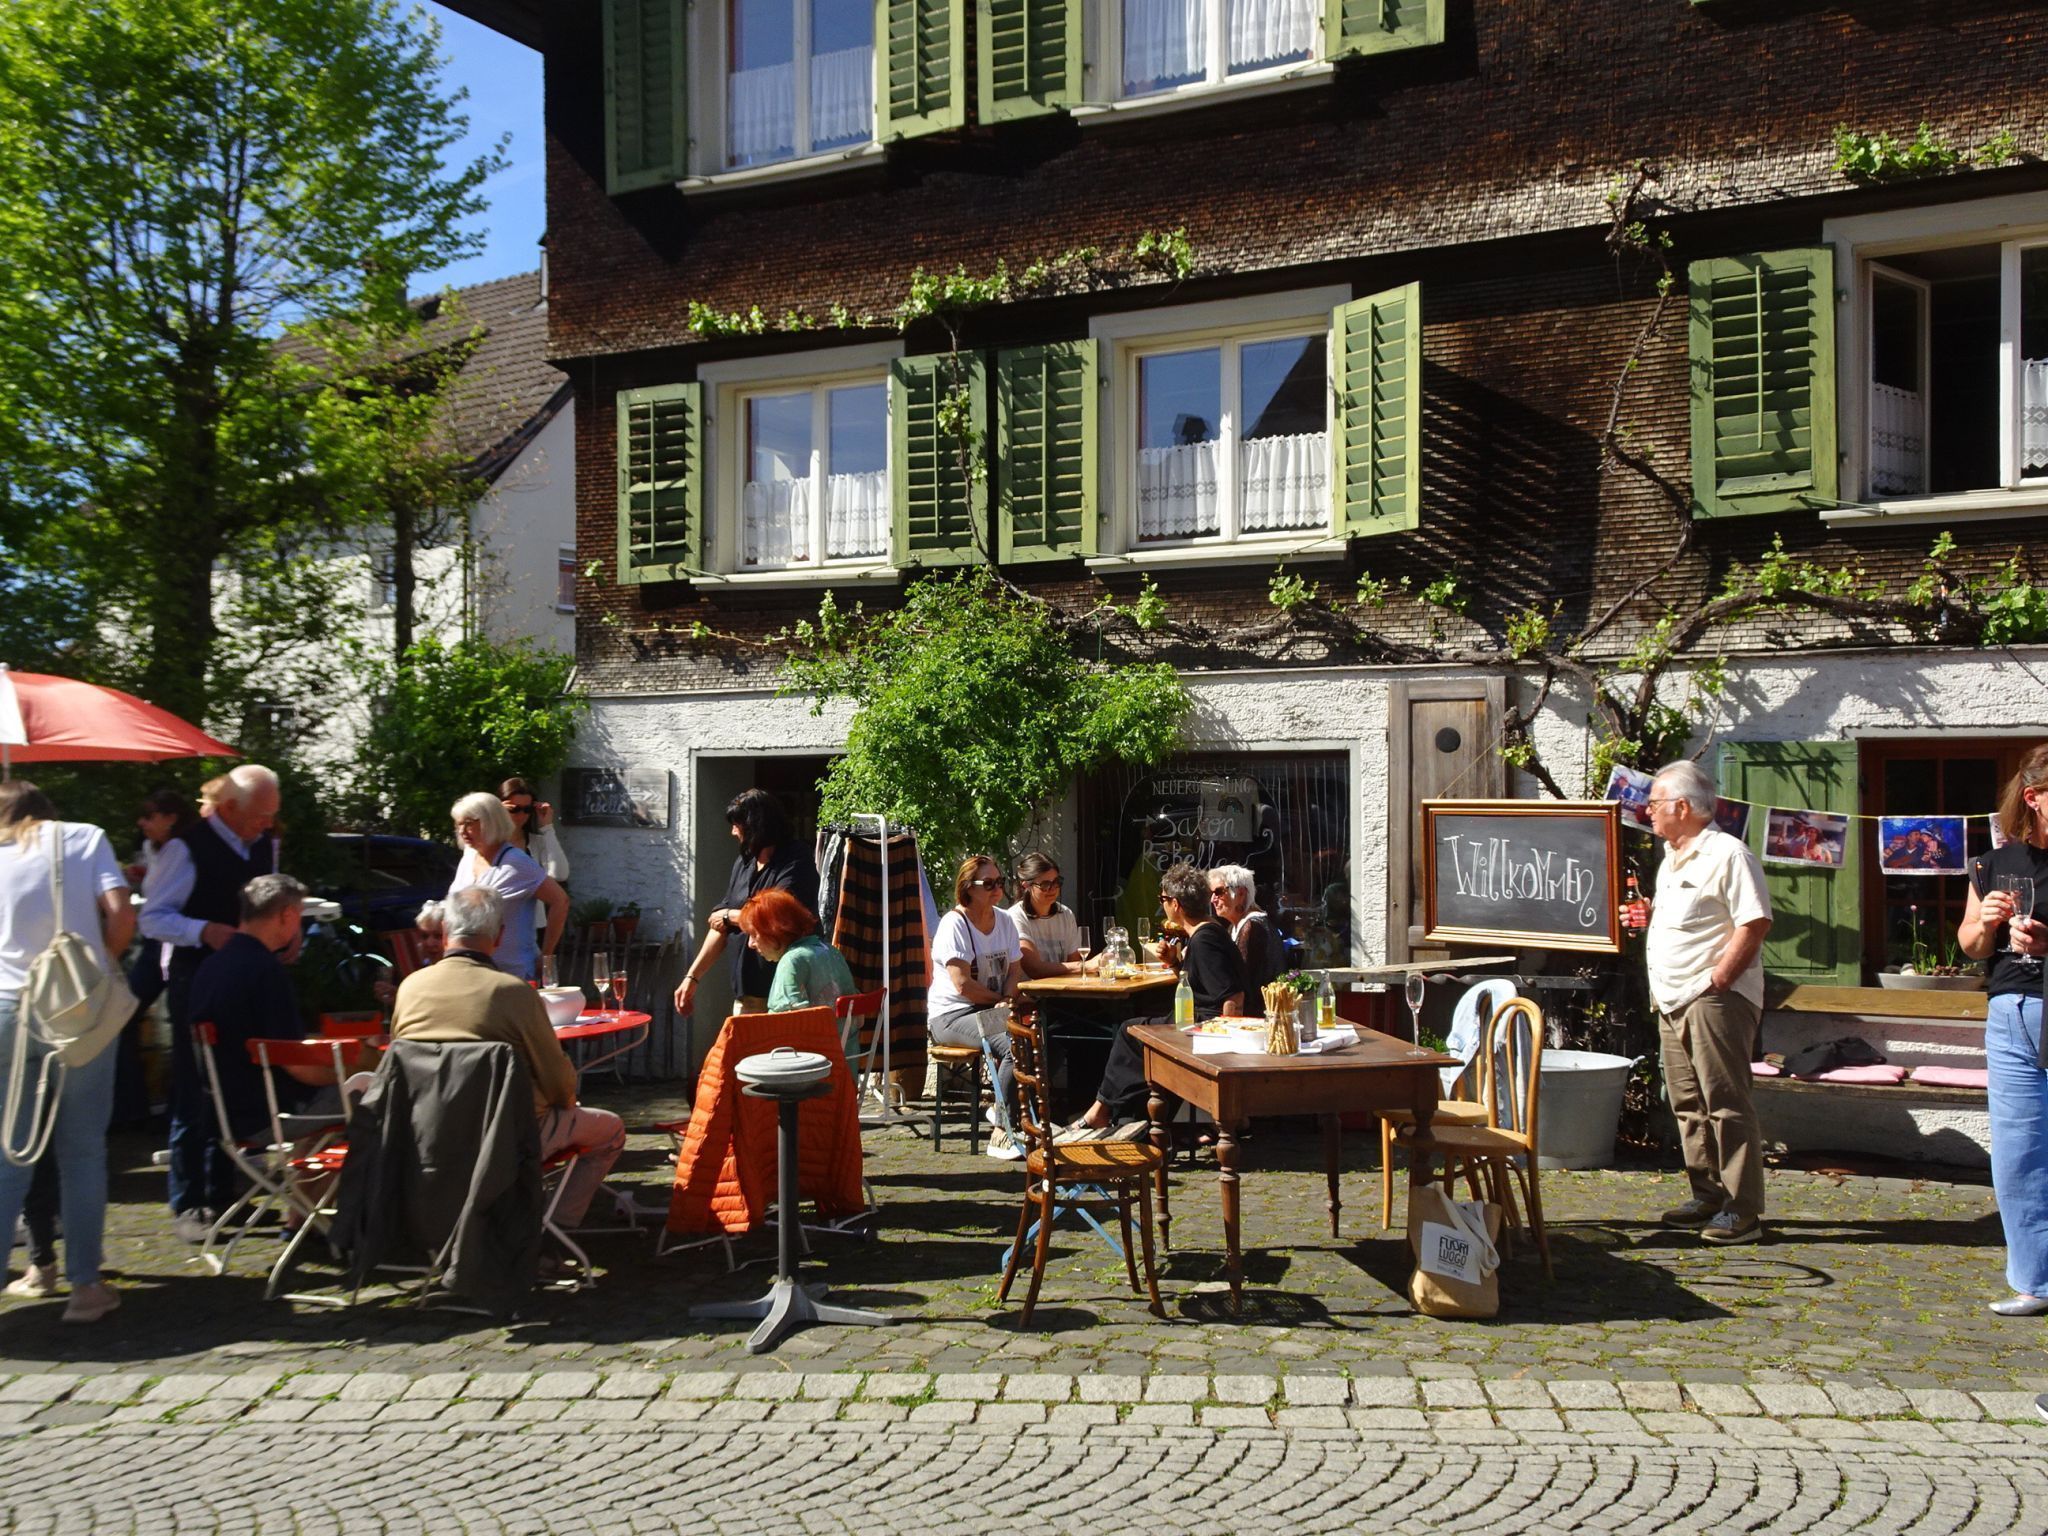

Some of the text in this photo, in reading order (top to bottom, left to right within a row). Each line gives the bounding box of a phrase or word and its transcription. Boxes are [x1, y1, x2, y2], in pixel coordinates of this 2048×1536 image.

[1153, 803, 1237, 838] Salon
[1440, 1236, 1469, 1256] FUORI
[1439, 1248, 1467, 1266] LUOGO
